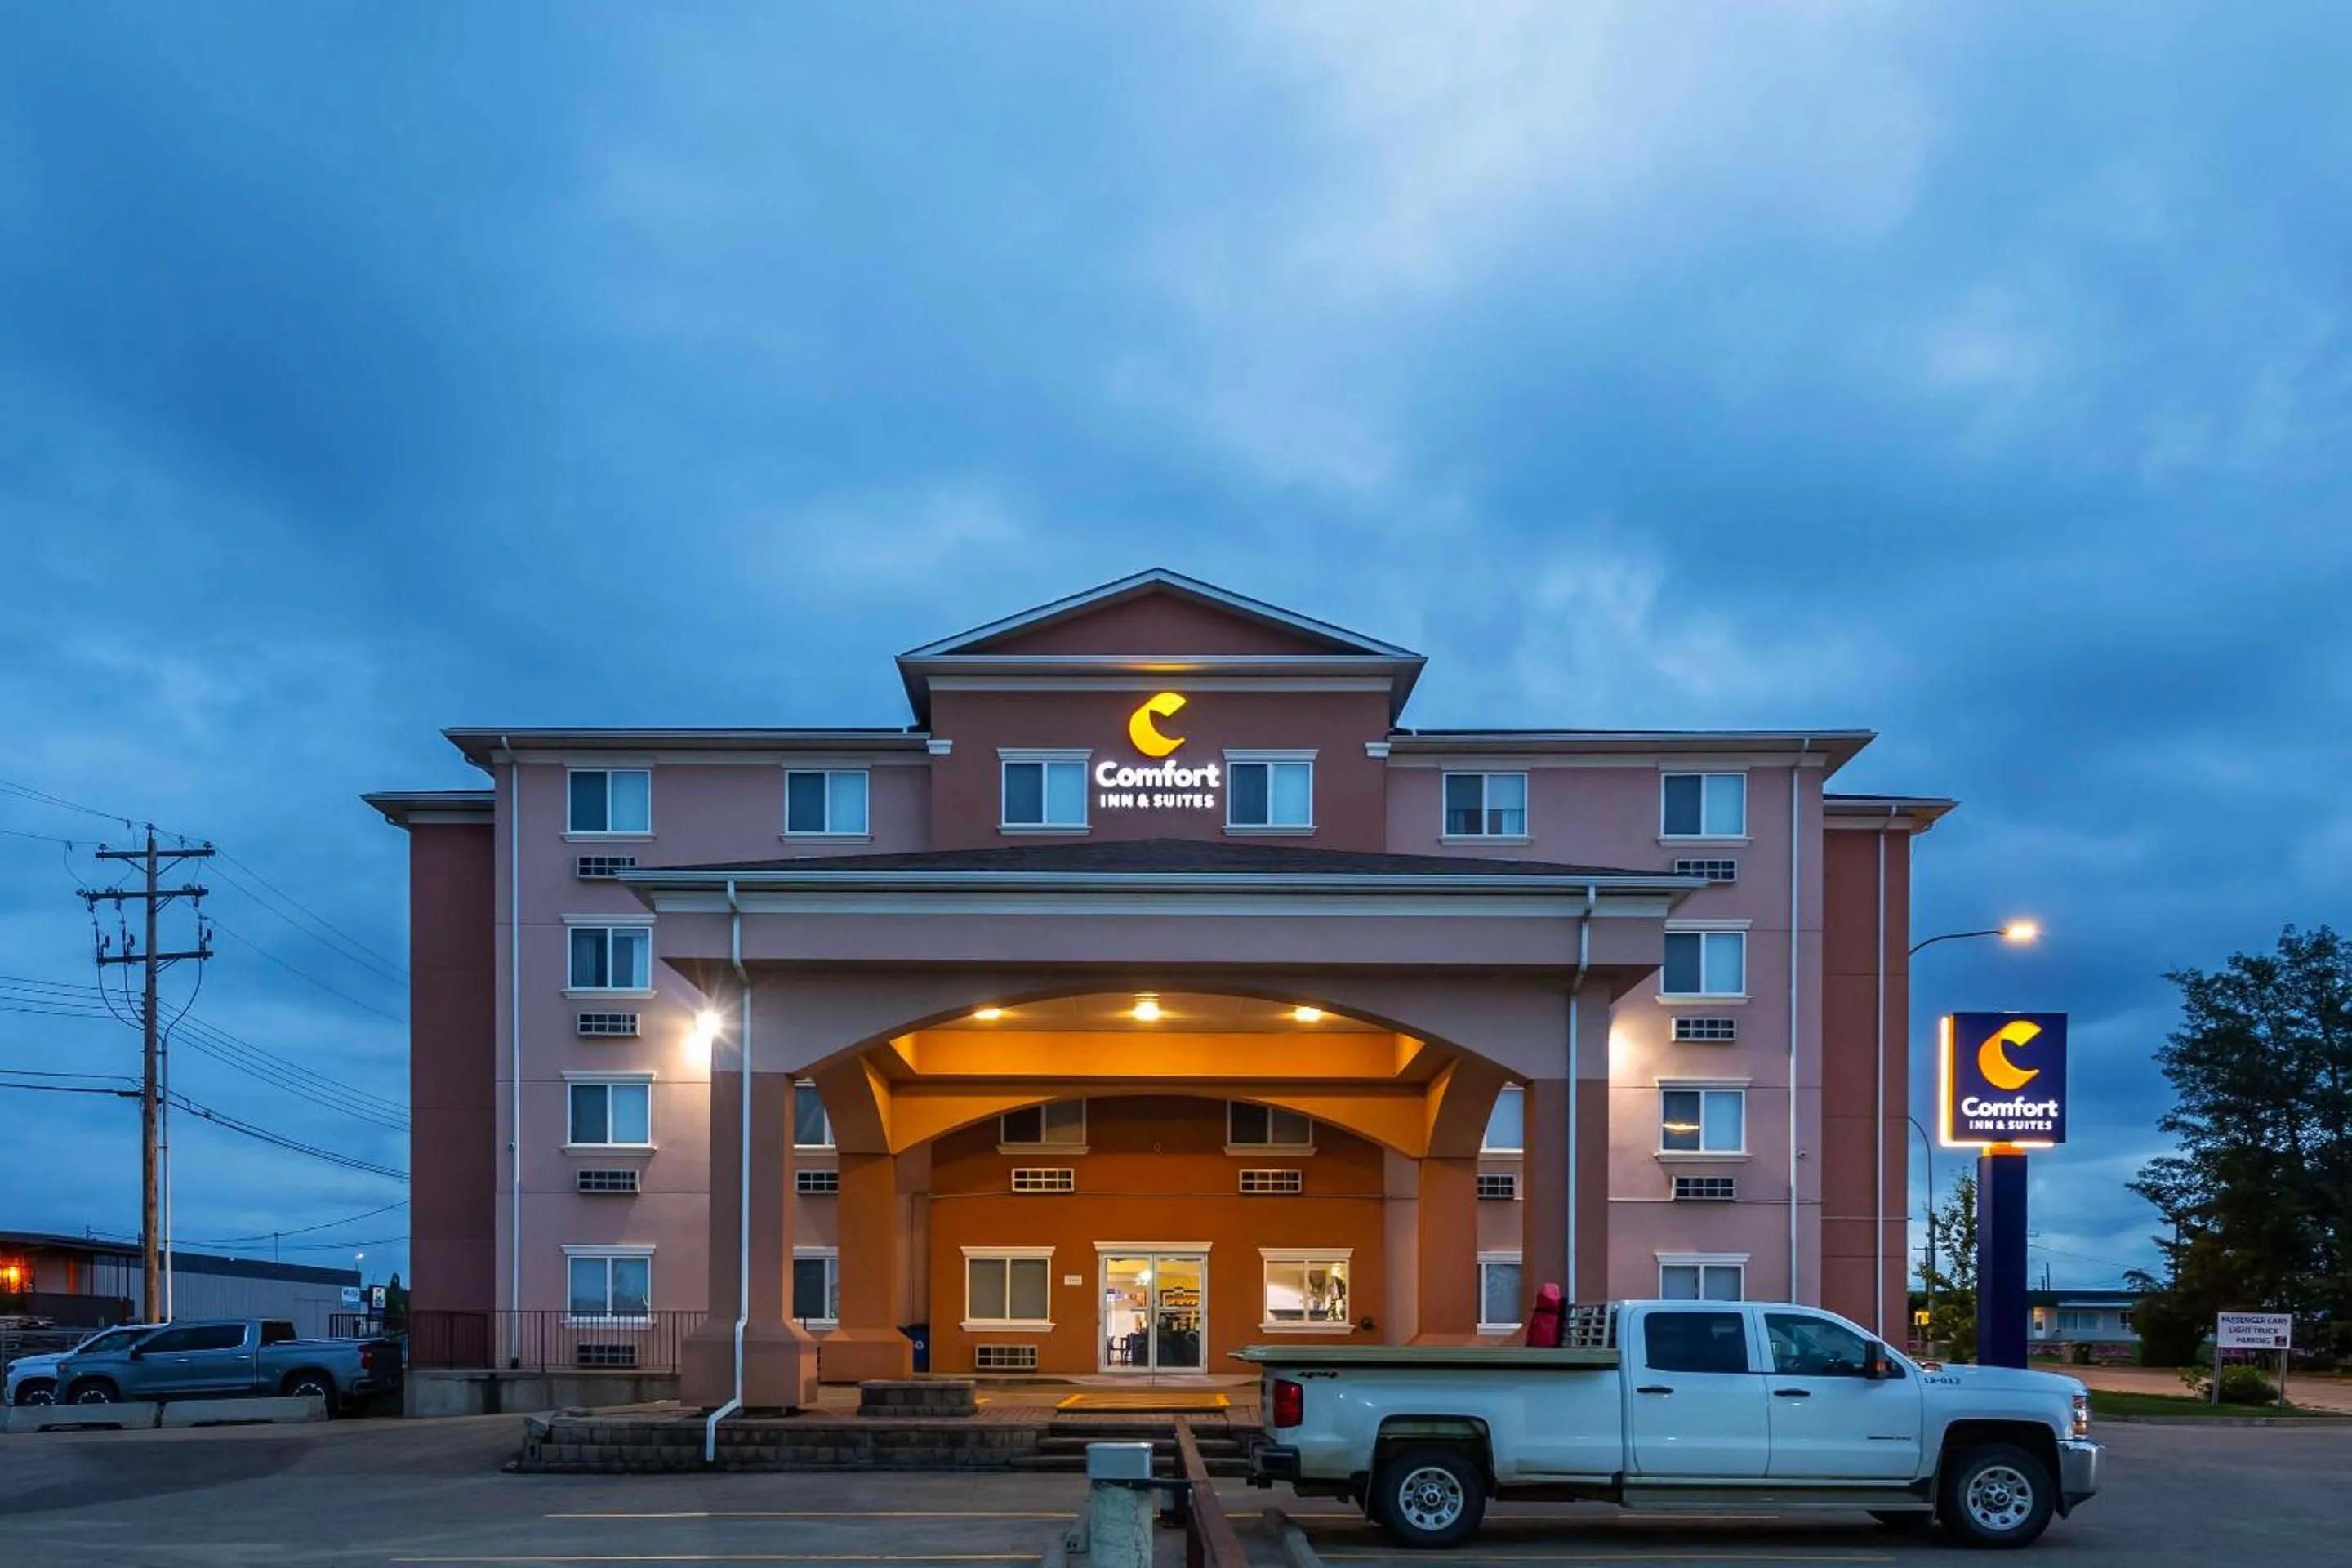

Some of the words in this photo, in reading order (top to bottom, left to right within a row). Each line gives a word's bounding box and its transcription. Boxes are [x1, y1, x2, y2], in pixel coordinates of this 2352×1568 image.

[1095, 760, 1220, 788] Comfort
[1100, 793, 1134, 808] INN
[1137, 793, 1149, 808] &
[1153, 793, 1214, 808] SUITES
[1961, 1096, 2058, 1117] Comfort
[1969, 1120, 1993, 1129] INN
[1996, 1120, 2006, 1129] &
[2007, 1120, 2052, 1130] SUITES
